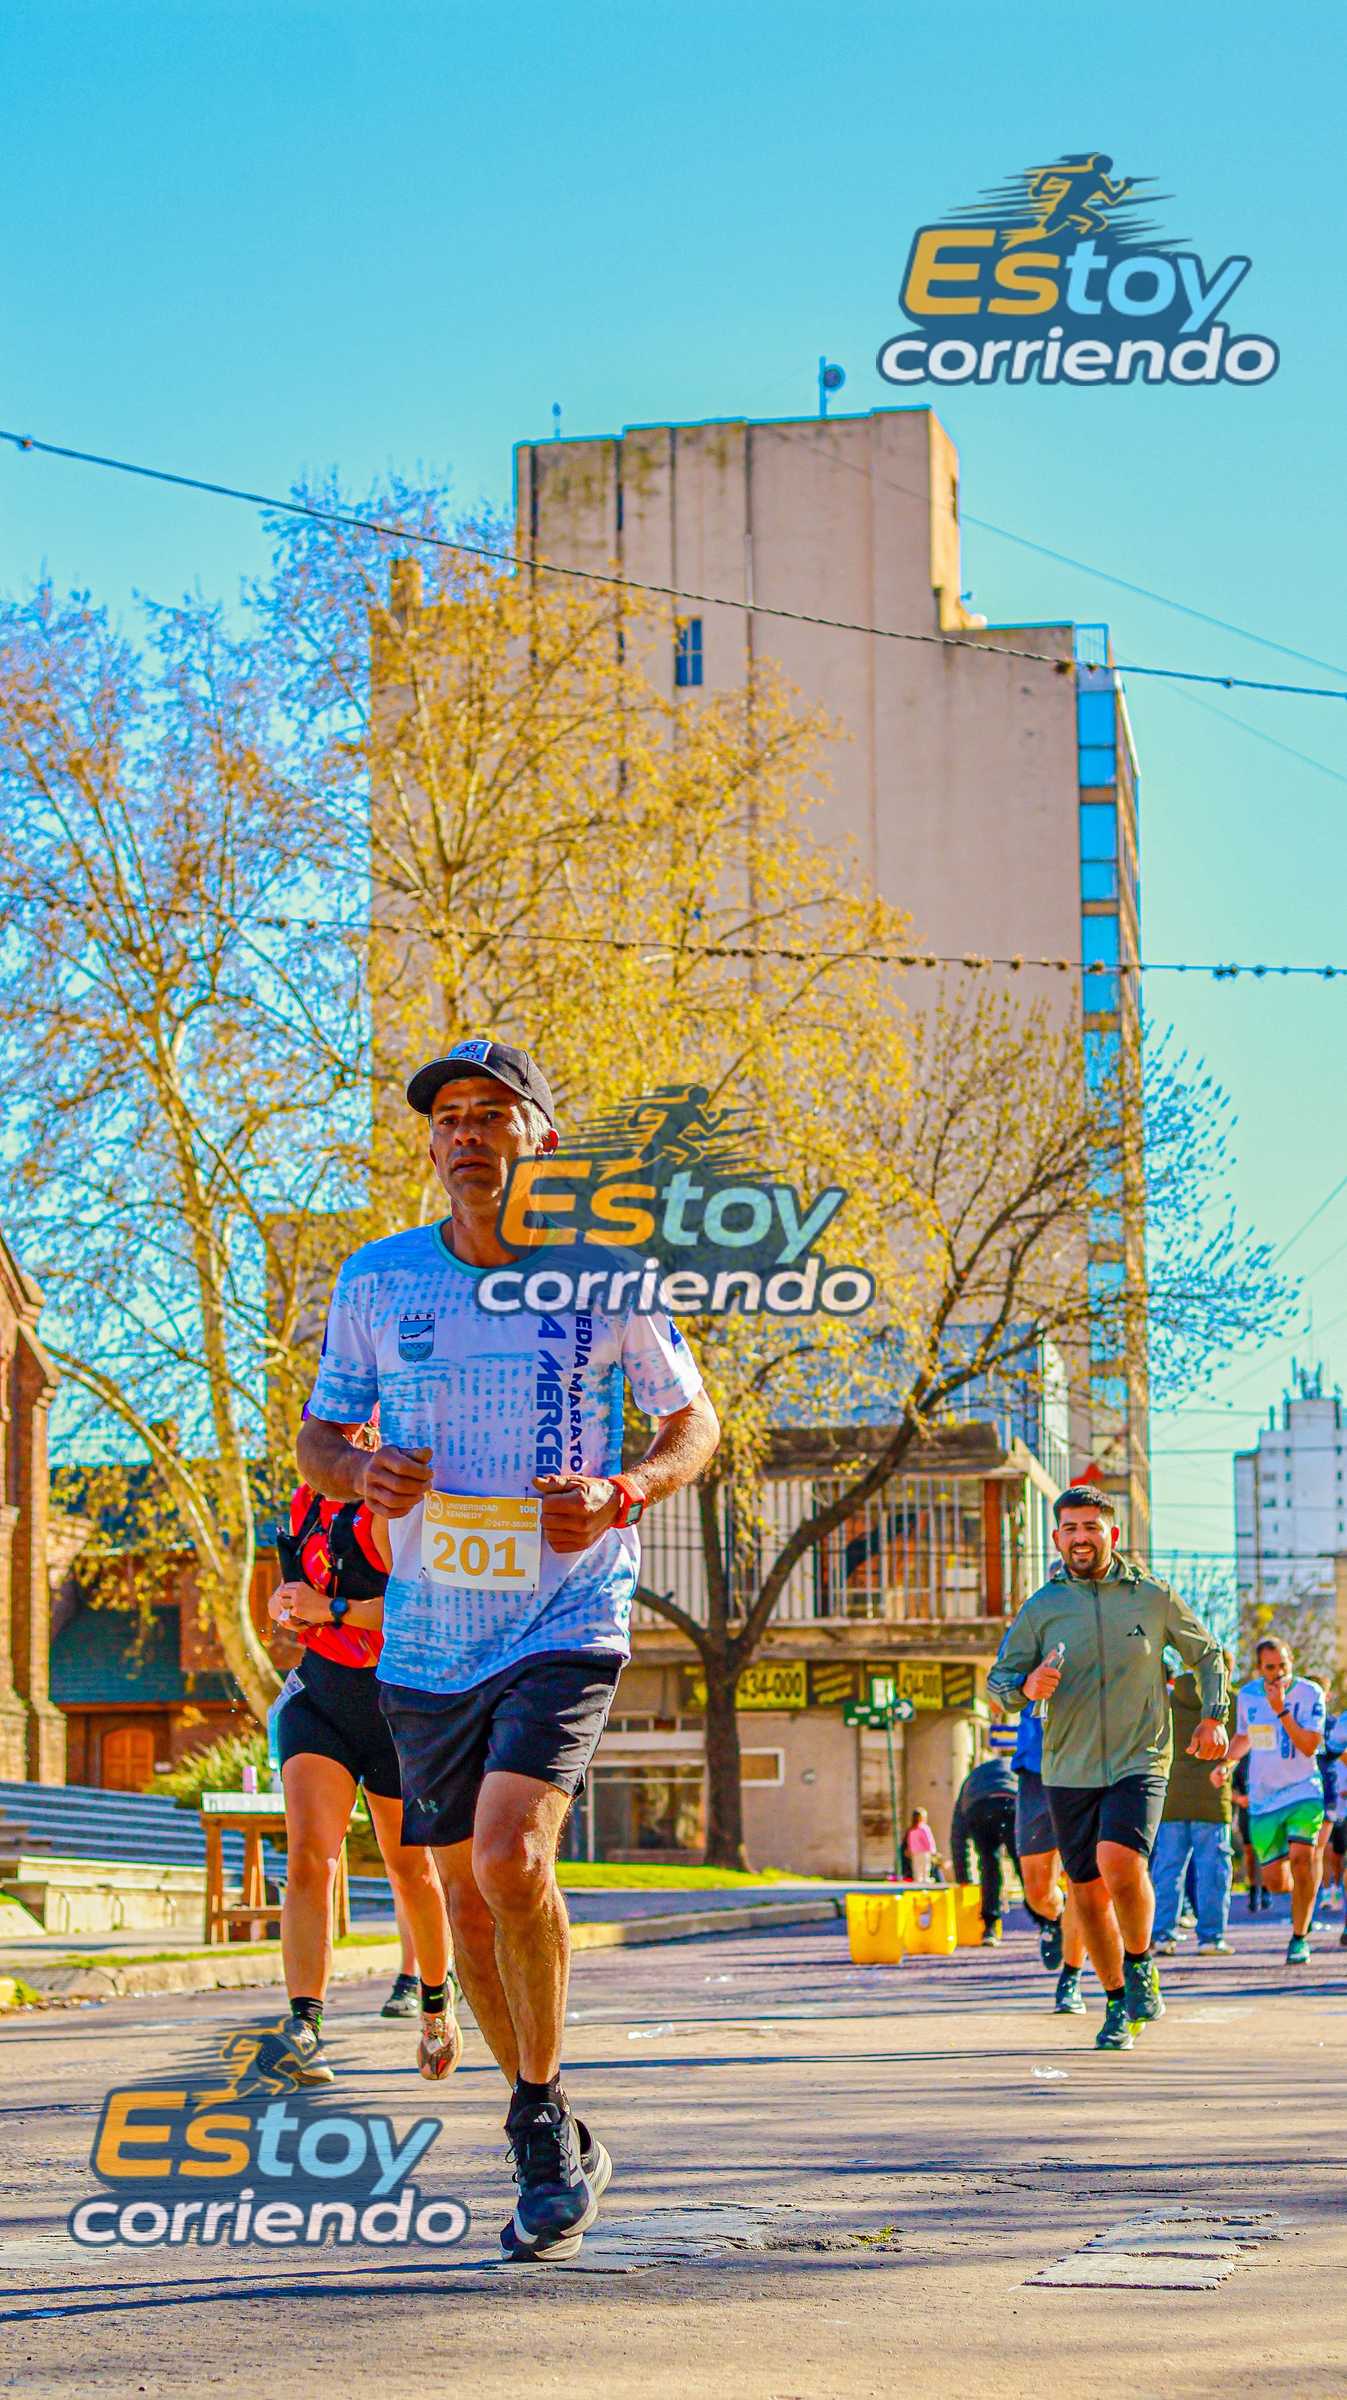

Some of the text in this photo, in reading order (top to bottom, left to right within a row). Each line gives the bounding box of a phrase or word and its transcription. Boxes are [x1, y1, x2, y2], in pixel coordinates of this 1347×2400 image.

[568, 1308, 593, 1475] EDIA MARATO
[432, 1532, 526, 1577] 201
